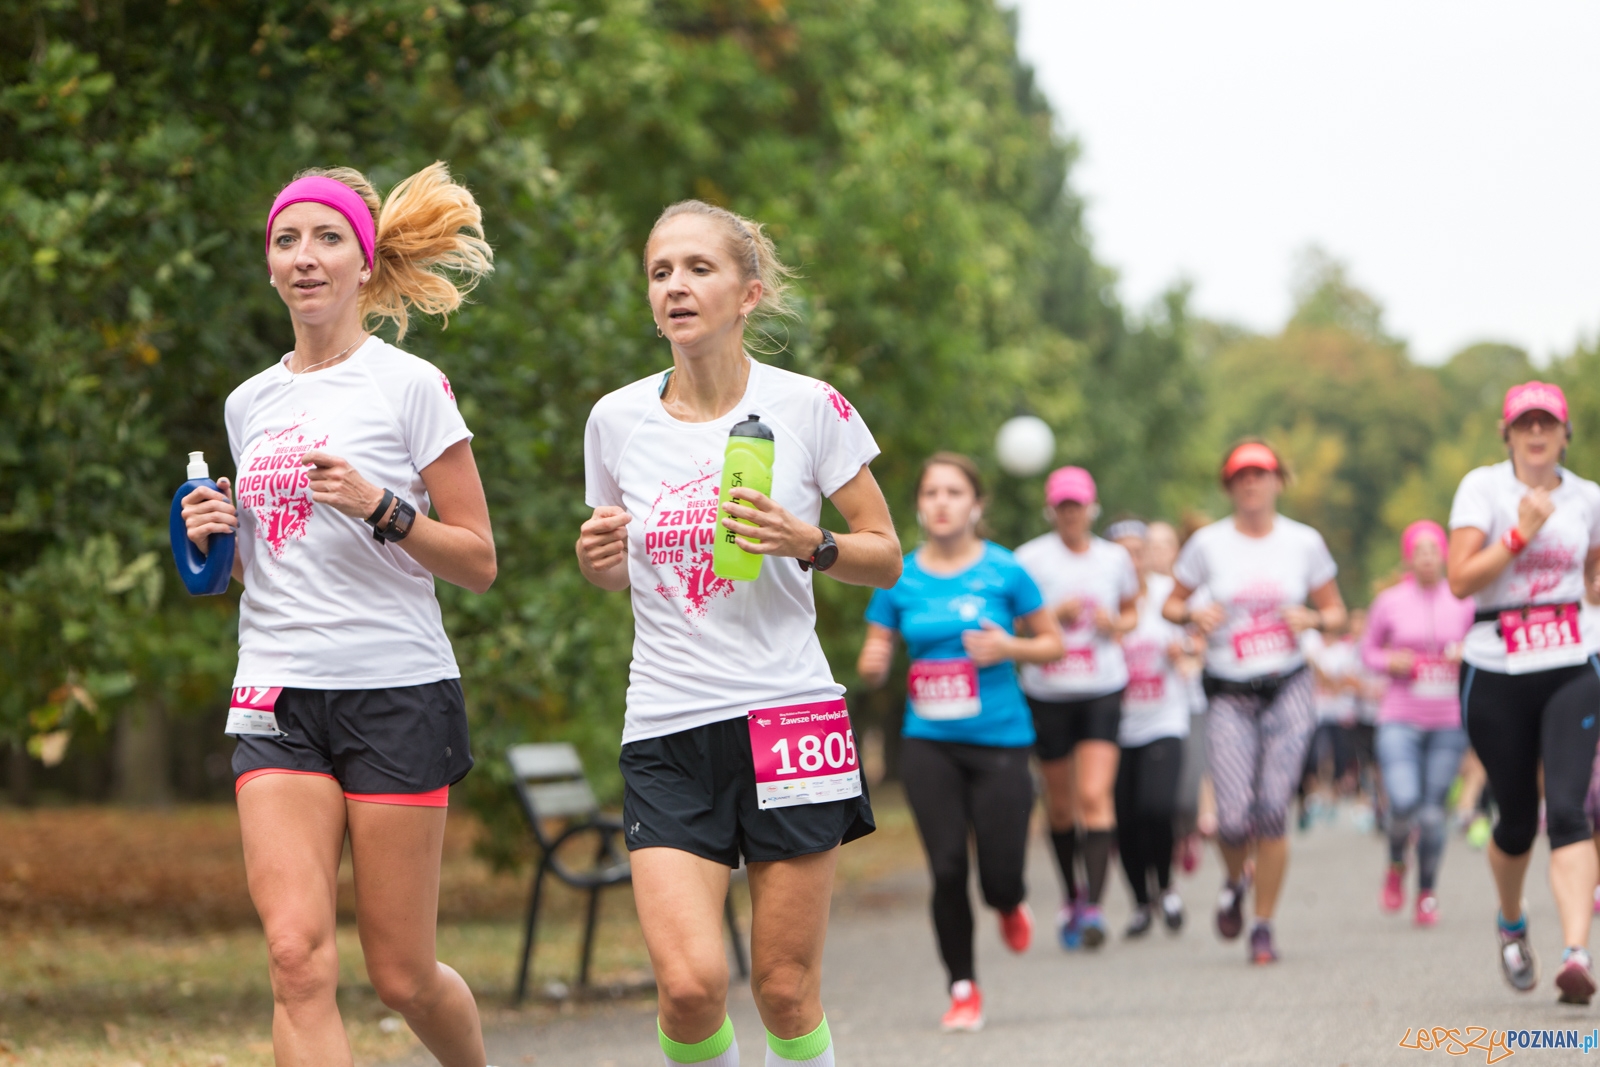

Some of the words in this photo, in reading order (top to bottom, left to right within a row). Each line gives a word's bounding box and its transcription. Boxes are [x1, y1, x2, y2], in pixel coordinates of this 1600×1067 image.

[275, 446, 290, 454] BIEG
[290, 444, 312, 453] KOBIET
[249, 453, 314, 472] zawsz
[238, 469, 311, 500] pier(w)s
[731, 471, 743, 488] SA
[242, 493, 265, 509] 2016
[687, 500, 706, 508] BIEG
[651, 549, 684, 566] 2016
[780, 715, 810, 726] Zawsze
[810, 710, 841, 722] Pier(w)si
[771, 728, 856, 775] 1805
